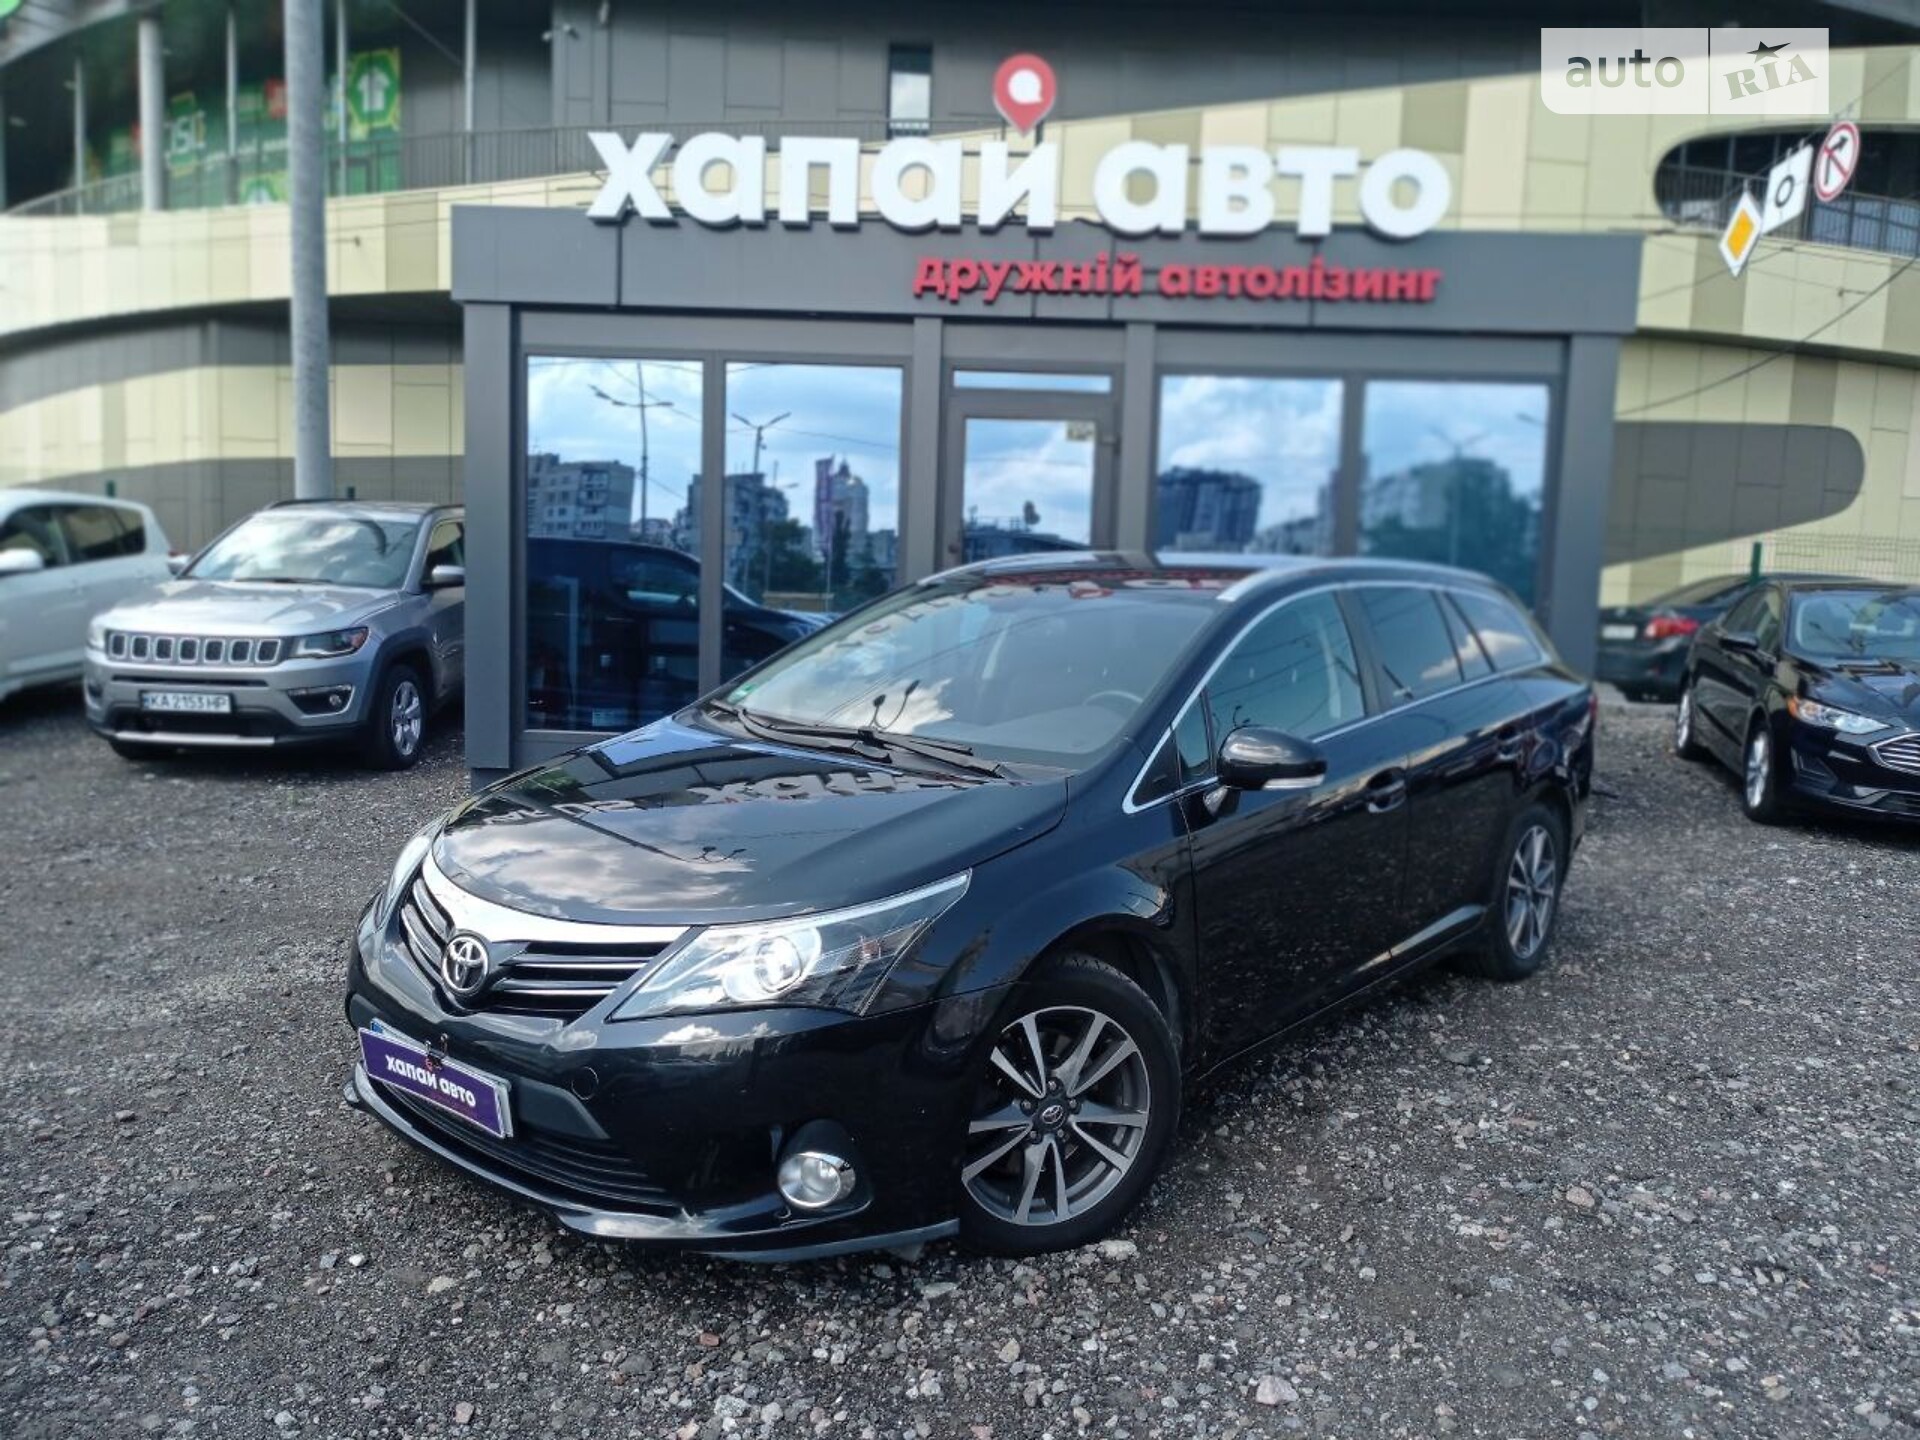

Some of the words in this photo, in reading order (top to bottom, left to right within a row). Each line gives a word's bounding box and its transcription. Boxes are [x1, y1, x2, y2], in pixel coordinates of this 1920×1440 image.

[1093, 139, 1452, 240] авто
[913, 252, 1142, 302] дружній
[1158, 254, 1442, 300] автолізинг
[438, 1077, 477, 1108] авто
